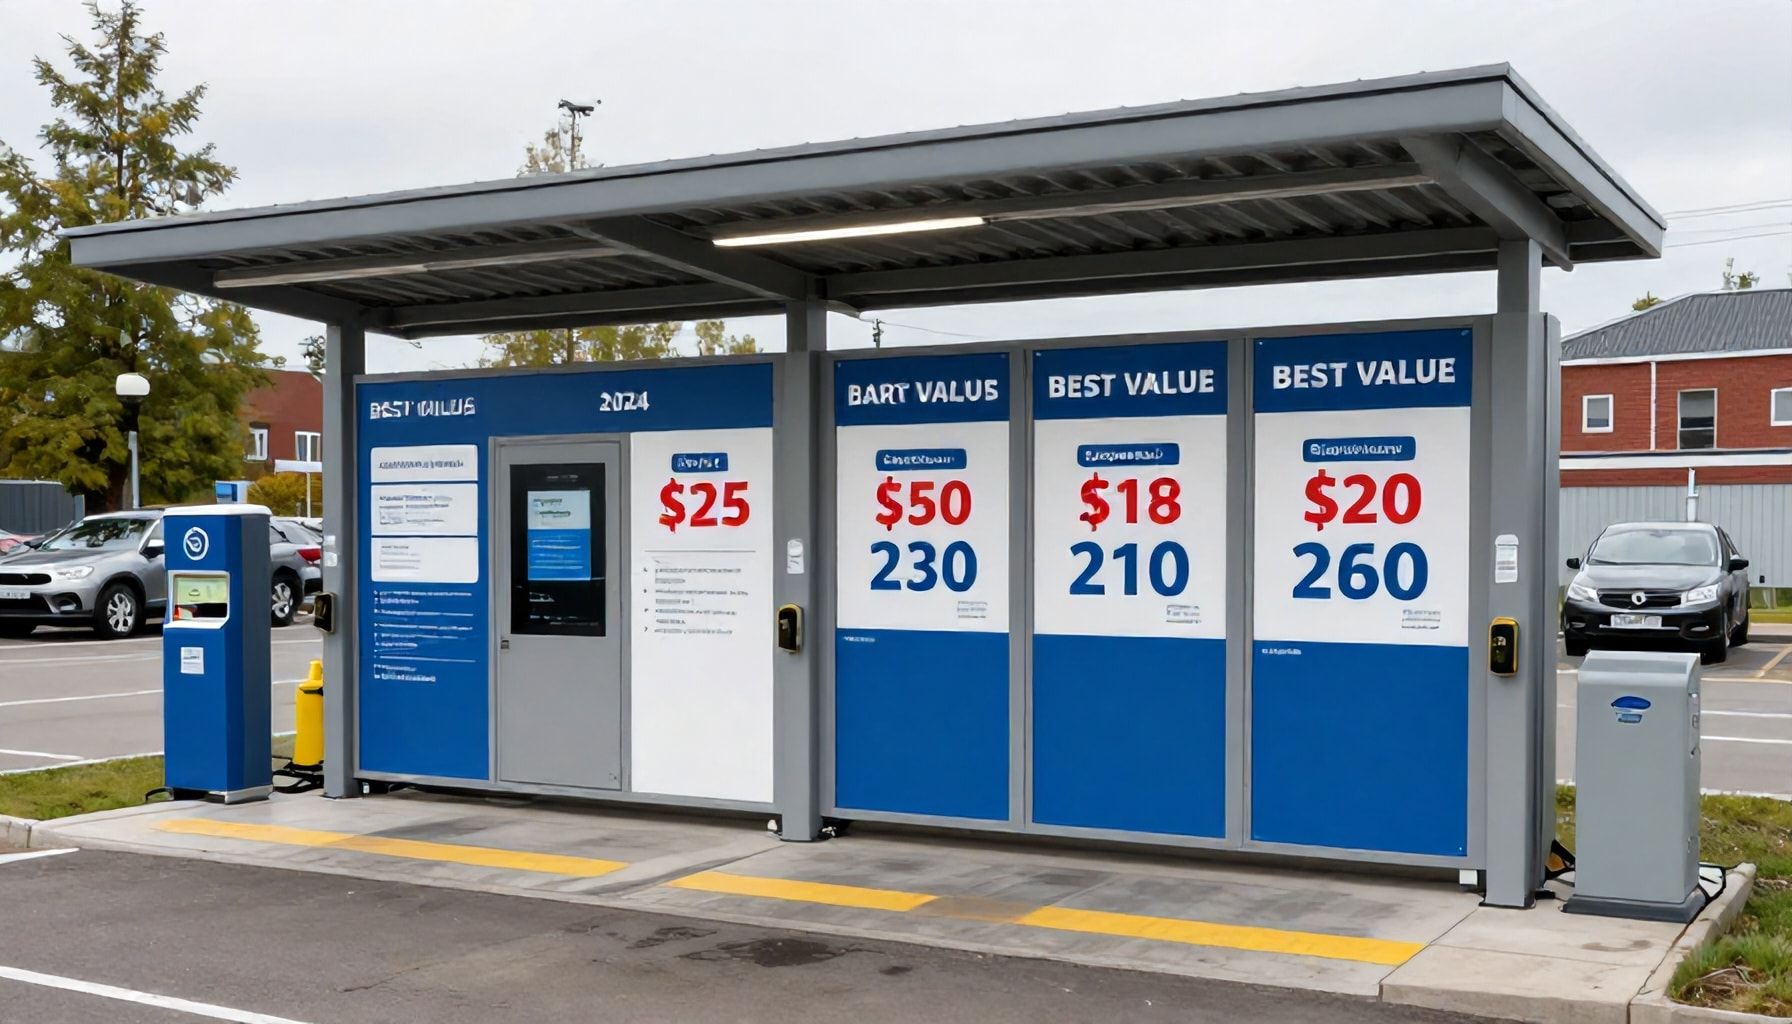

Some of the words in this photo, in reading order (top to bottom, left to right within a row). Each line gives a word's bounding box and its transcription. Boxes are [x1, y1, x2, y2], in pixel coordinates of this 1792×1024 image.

[599, 391, 650, 412] 2024
[1048, 372, 1116, 398] BEST
[1124, 369, 1215, 396] VALUE
[1273, 361, 1349, 390] BEST
[1356, 357, 1456, 386] VALUE
[659, 477, 750, 533] $25
[875, 476, 972, 532] $50
[1079, 472, 1182, 532] $18
[1303, 468, 1423, 531] $20
[870, 540, 978, 593] 230
[1069, 540, 1190, 597] 210
[1292, 541, 1429, 602] 260
